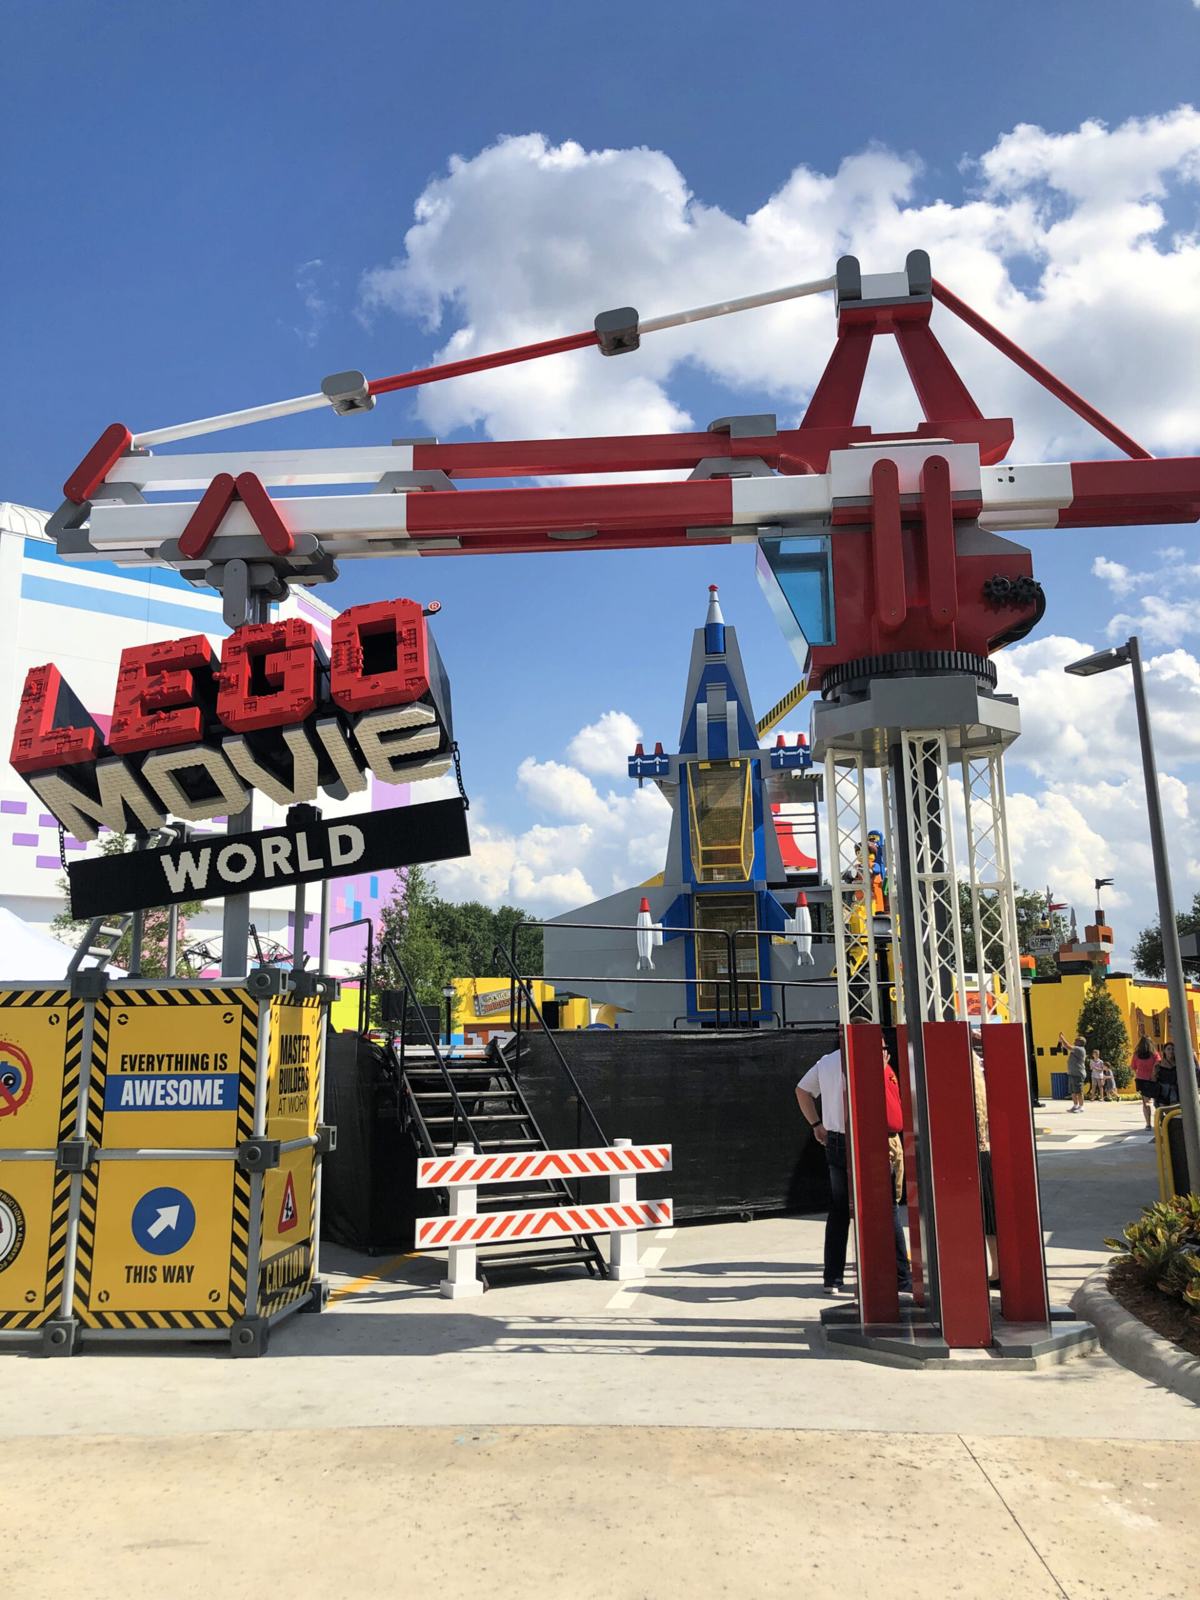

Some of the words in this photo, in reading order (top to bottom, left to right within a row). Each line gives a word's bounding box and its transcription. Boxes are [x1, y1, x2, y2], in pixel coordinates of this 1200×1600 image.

[10, 598, 430, 773] LEGO
[29, 701, 453, 843] MOVIE
[160, 824, 366, 893] WORLD
[120, 1053, 210, 1072] EVERYTHING
[213, 1052, 228, 1071] IS
[280, 1034, 310, 1065] MASTER
[120, 1079, 224, 1106] AWESOME
[279, 1066, 309, 1095] BUILDERS
[278, 1097, 287, 1116] AT
[288, 1094, 307, 1114] WORK
[125, 1264, 158, 1284] THIS
[162, 1264, 195, 1284] WAY
[266, 1246, 305, 1295] CAUTION
